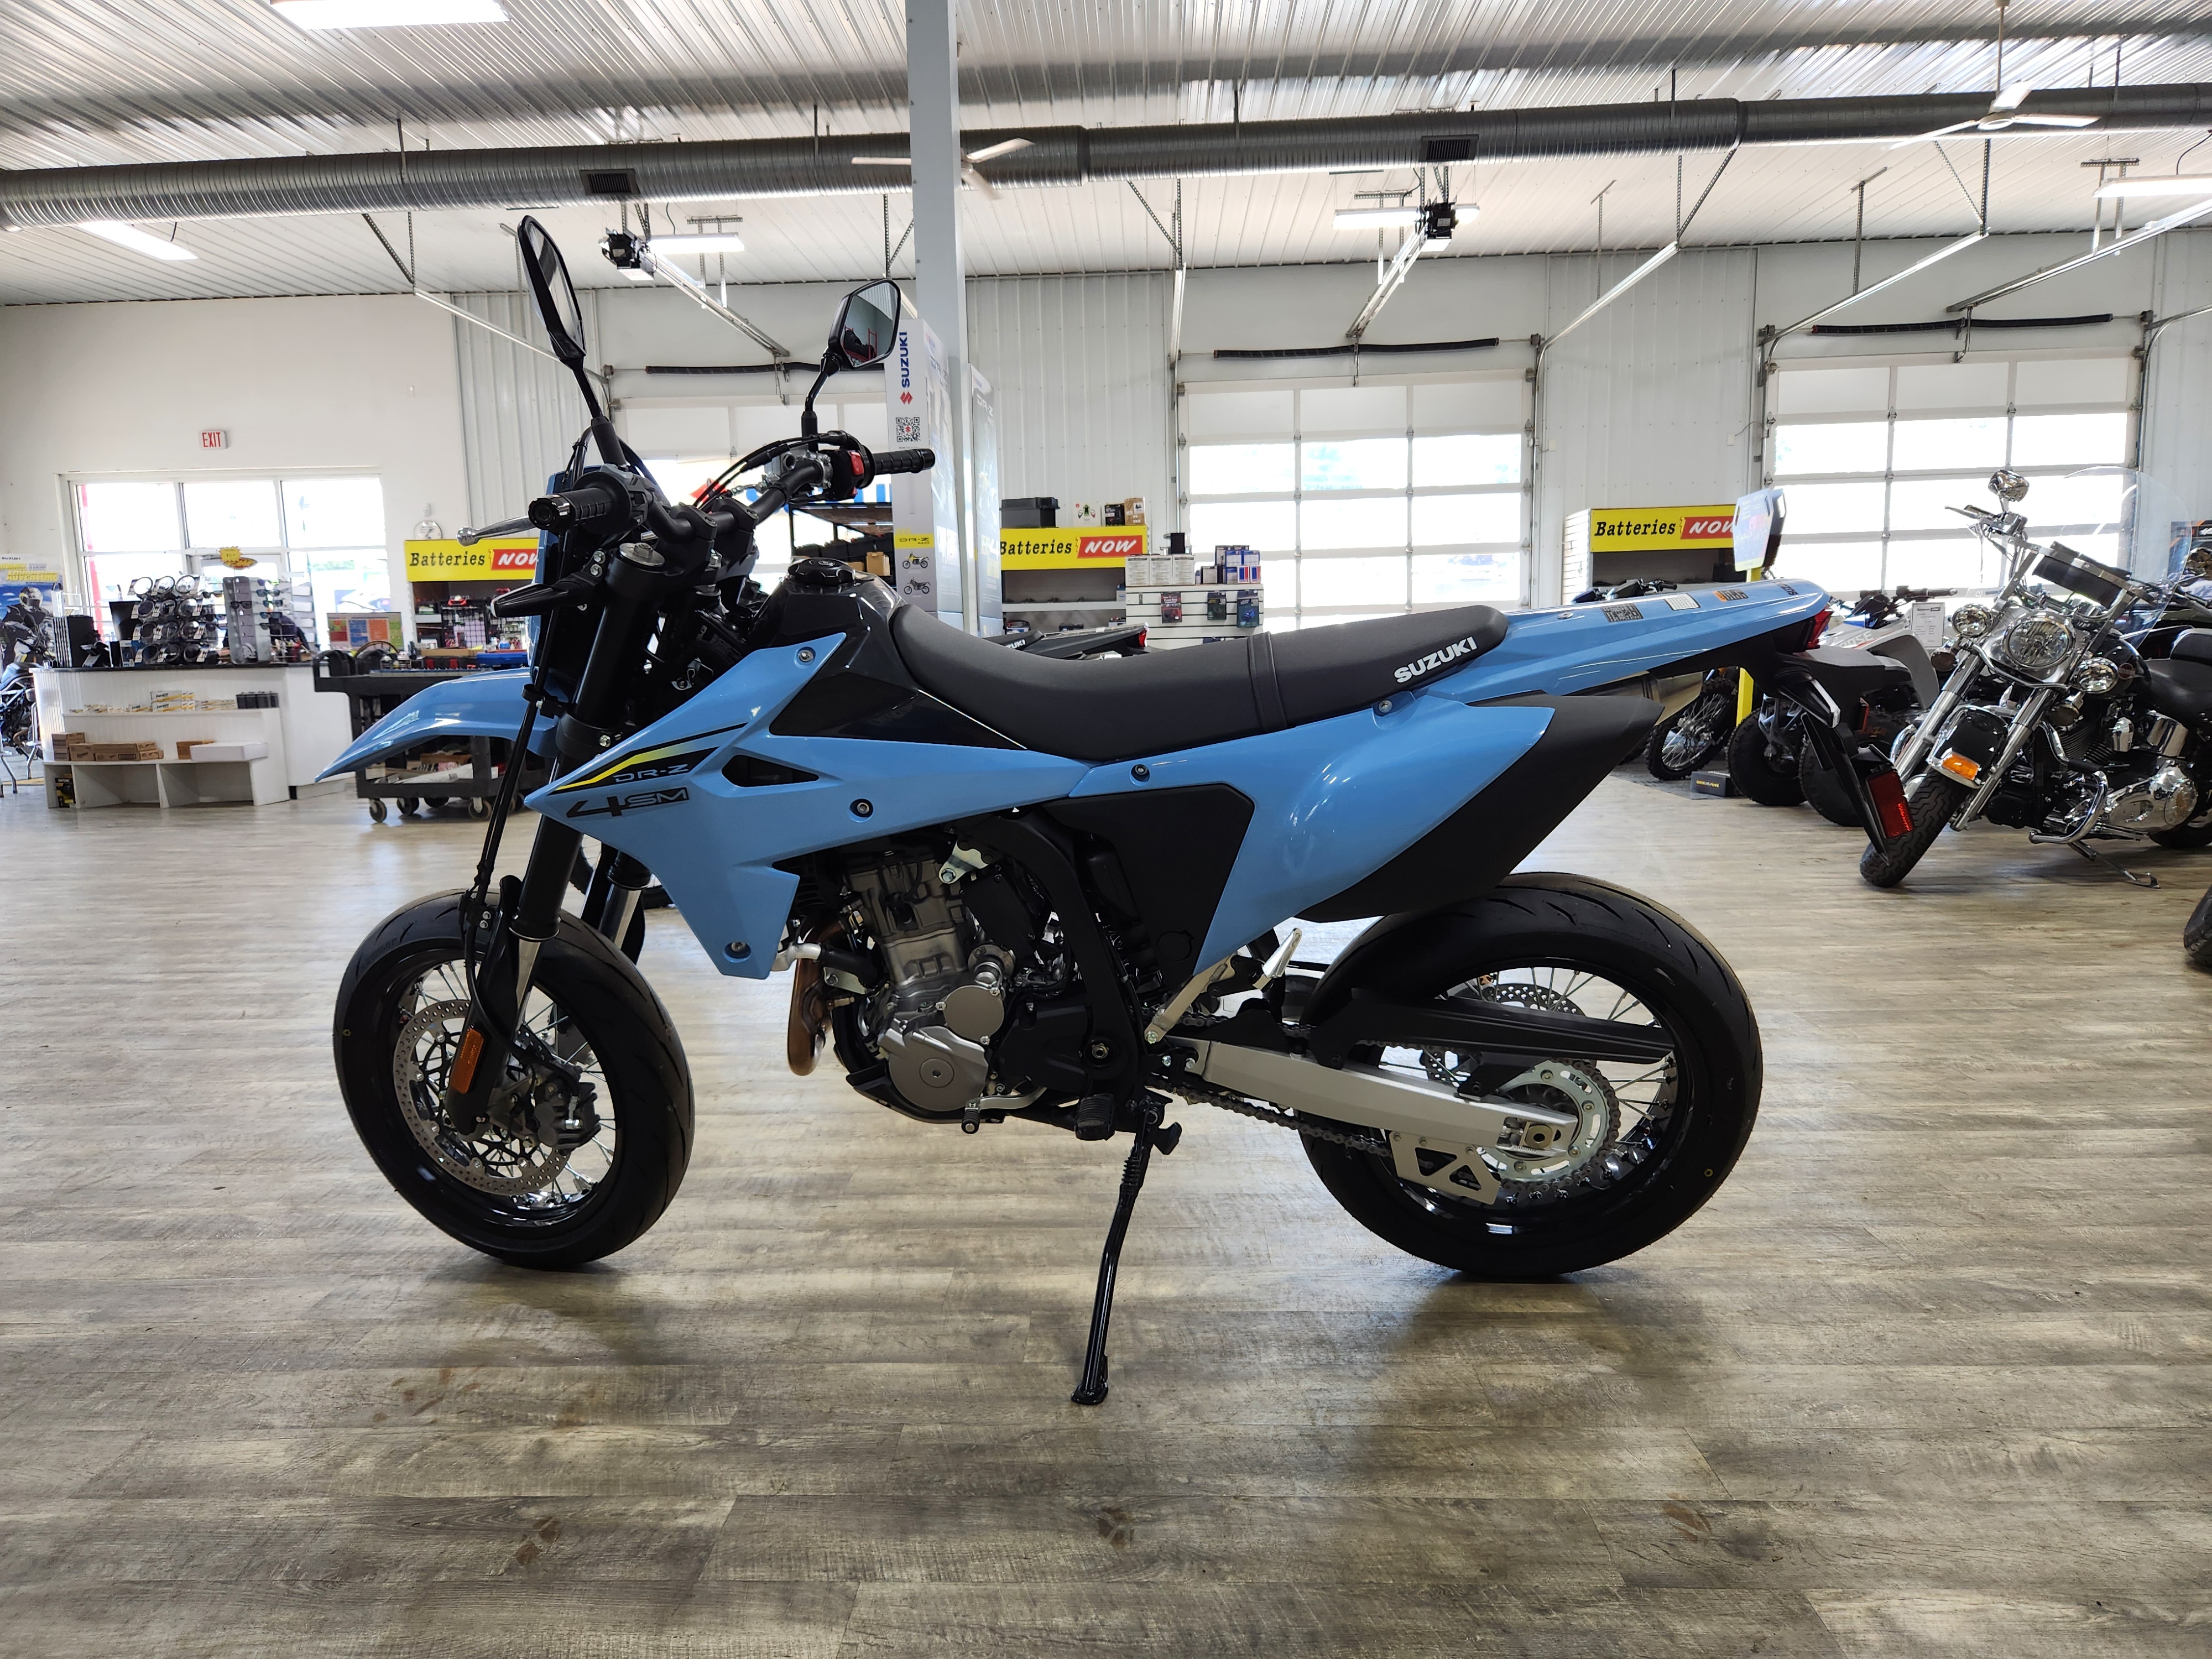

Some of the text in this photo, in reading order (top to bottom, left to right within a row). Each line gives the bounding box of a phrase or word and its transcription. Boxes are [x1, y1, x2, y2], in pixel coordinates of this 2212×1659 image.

[899, 332, 910, 388] SUZUKI
[202, 432, 221, 447] EXIT
[1594, 518, 1676, 537] Batteries
[1000, 539, 1072, 556] Batteries
[1084, 540, 1137, 554] NOW
[409, 551, 486, 567] Batteries
[1006, 639, 1026, 649] ZUKI
[1394, 636, 1478, 684] SUZUKI
[612, 764, 690, 783] DR-Z
